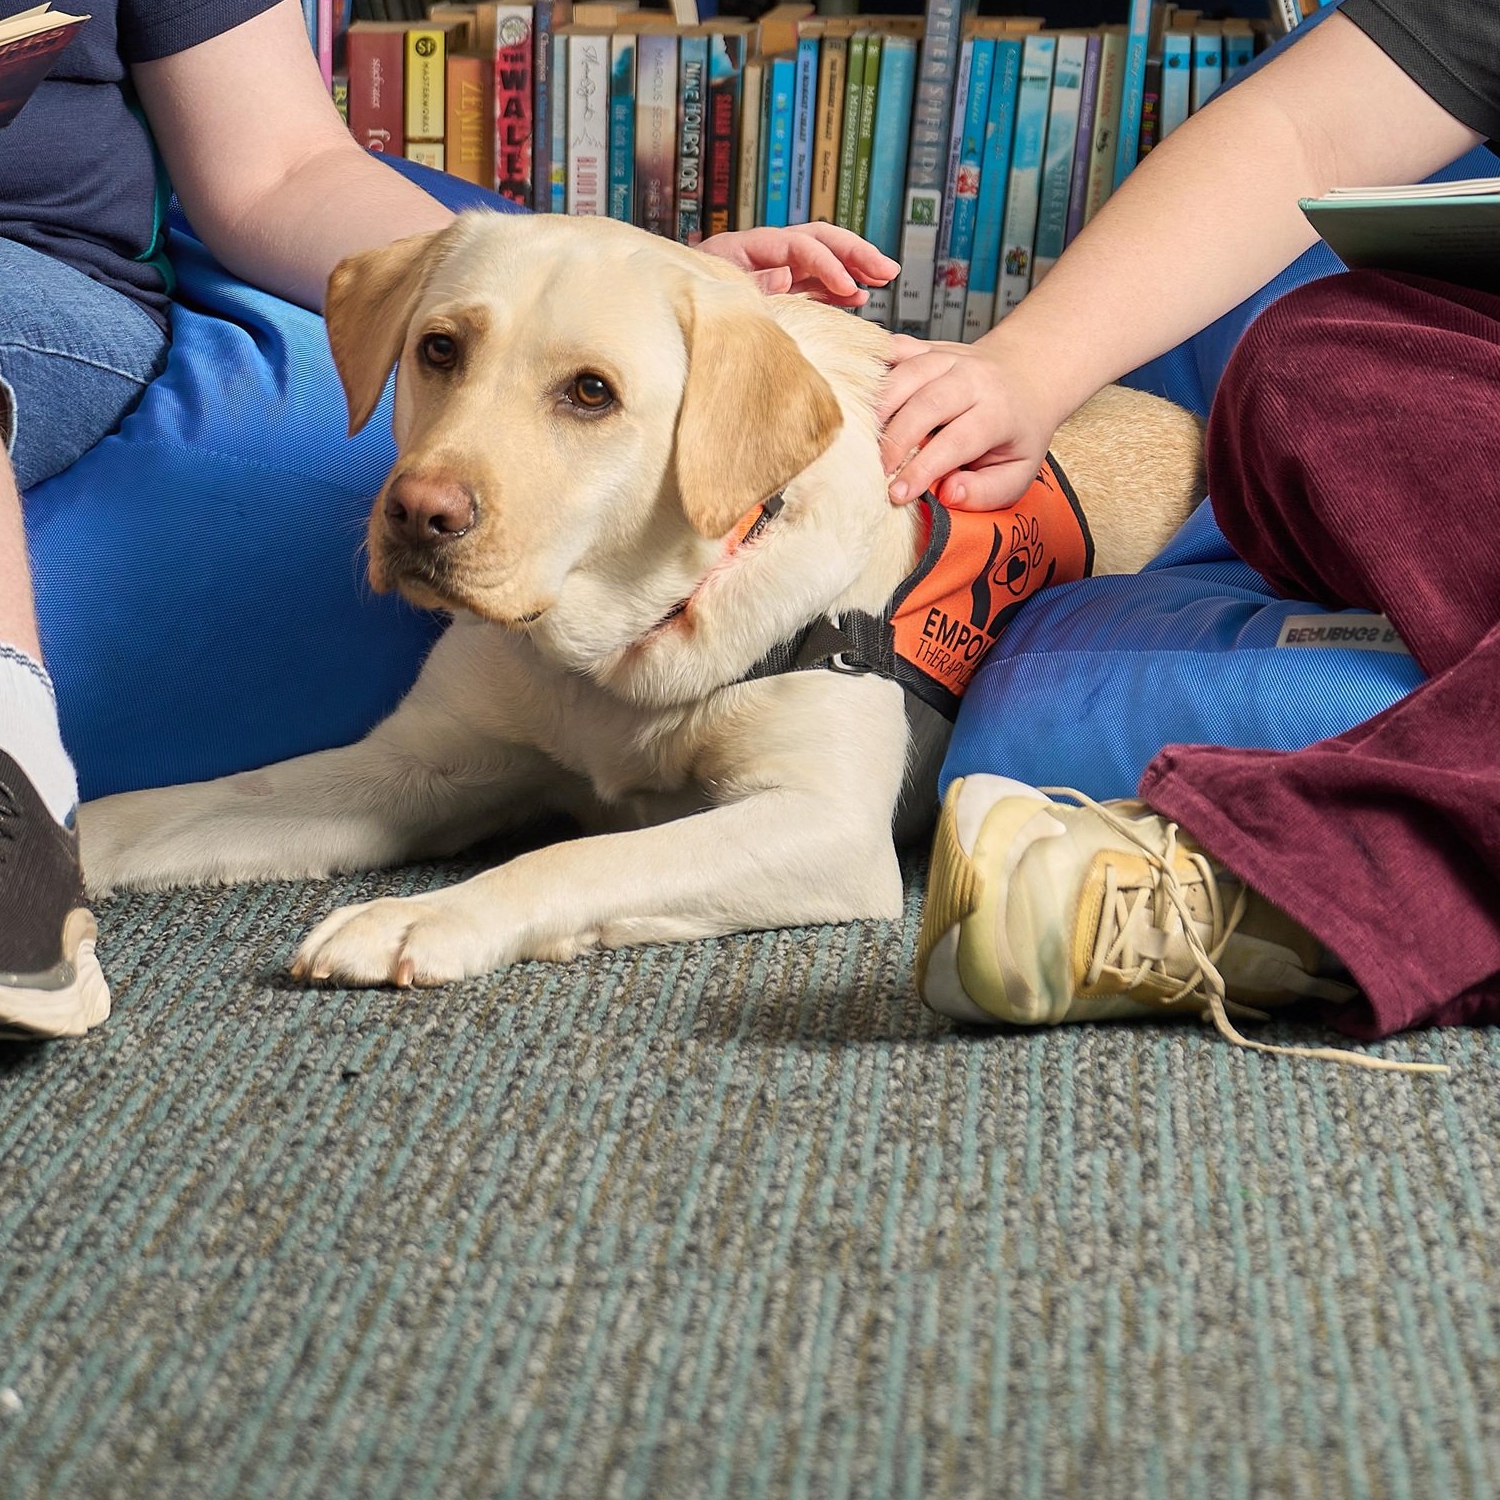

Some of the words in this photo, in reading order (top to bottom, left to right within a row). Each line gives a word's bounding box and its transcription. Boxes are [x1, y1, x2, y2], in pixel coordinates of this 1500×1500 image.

[934, 6, 952, 75] PETER
[683, 61, 702, 102] NINE
[459, 80, 484, 166] ZENITH
[681, 102, 702, 156] HOURS
[1047, 163, 1070, 233] SHREVE
[922, 606, 990, 666] EMPO
